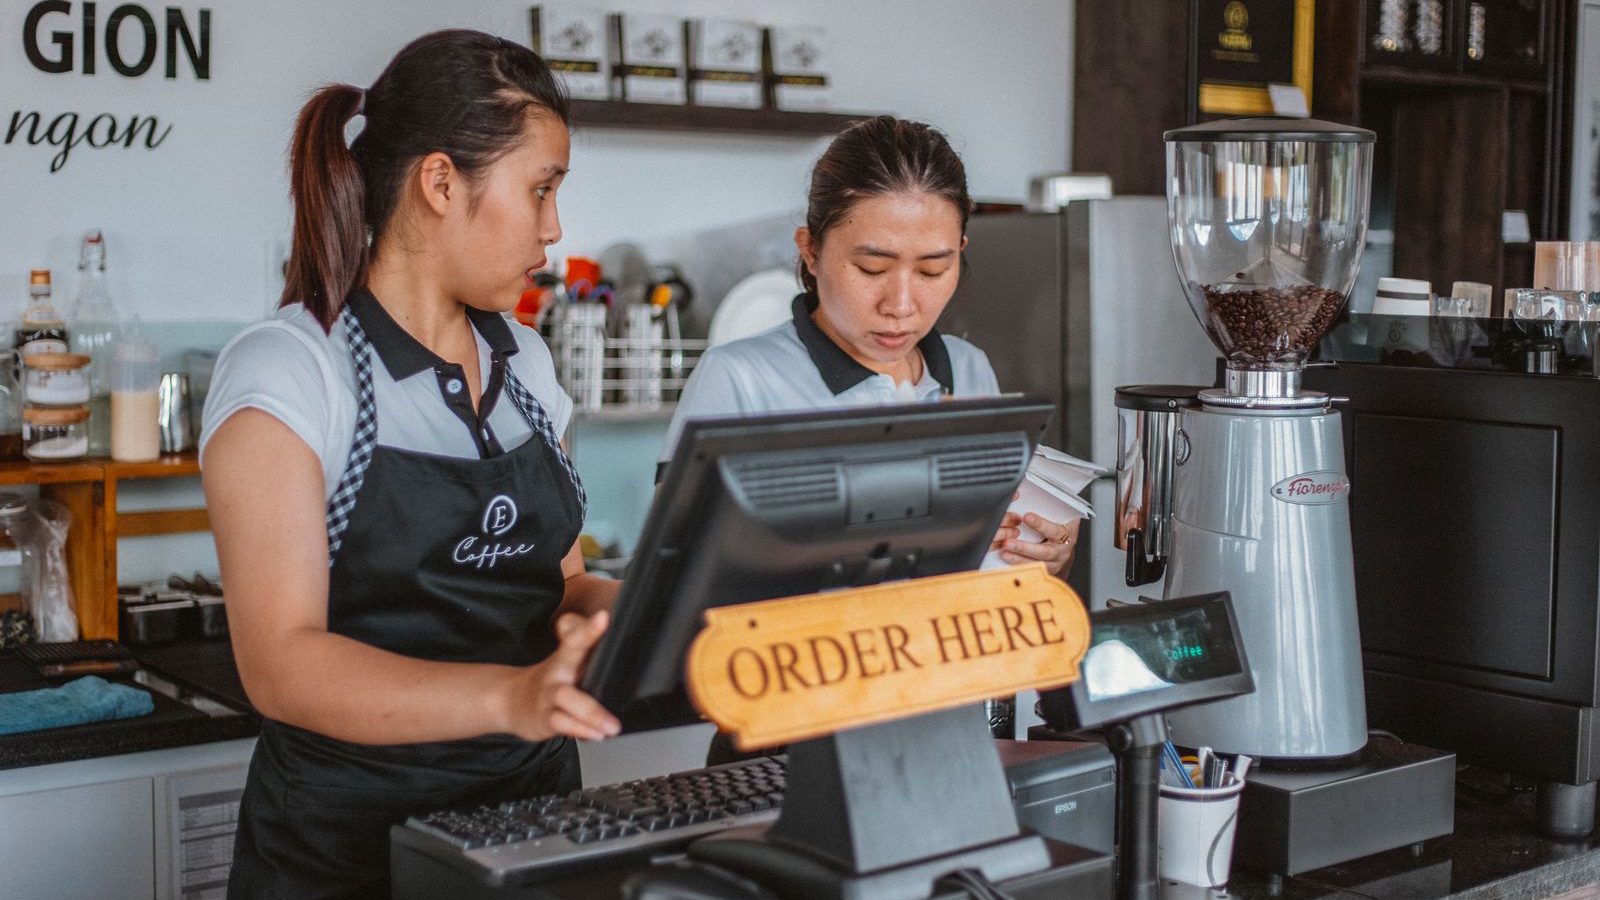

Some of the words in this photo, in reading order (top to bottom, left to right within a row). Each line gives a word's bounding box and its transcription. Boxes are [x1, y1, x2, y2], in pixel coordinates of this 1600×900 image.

[23, 0, 211, 80] GION
[5, 110, 173, 174] ngon
[454, 536, 535, 568] Coffee
[727, 623, 923, 700] ORDER
[931, 599, 1065, 664] HERE
[1055, 800, 1077, 814] EPSON
